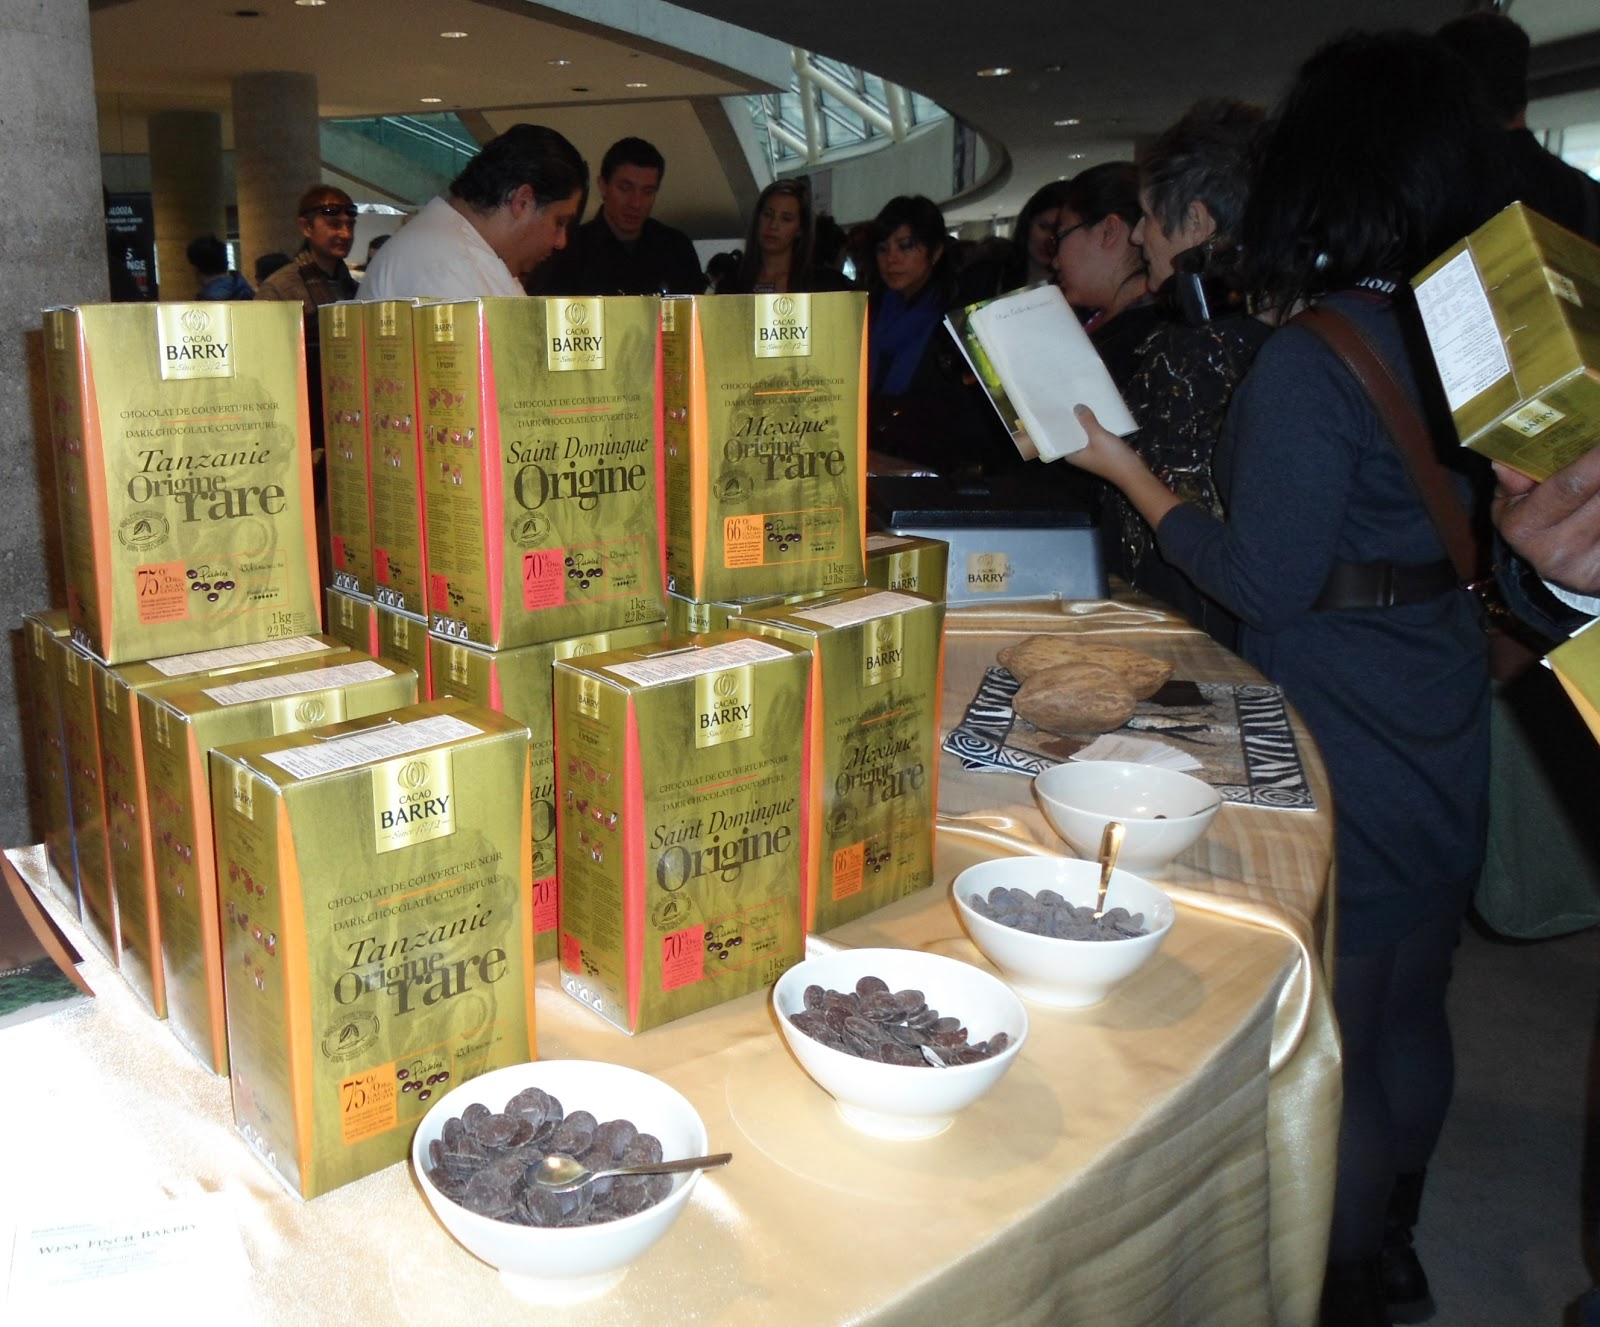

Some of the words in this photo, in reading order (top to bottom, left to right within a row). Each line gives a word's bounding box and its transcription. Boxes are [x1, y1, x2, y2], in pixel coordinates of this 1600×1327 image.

[182, 335, 212, 344] CACAO
[552, 337, 603, 352] BARRY
[565, 328, 590, 336] CACAO
[760, 327, 808, 341] BARRY
[166, 343, 229, 361] BARRY
[119, 408, 175, 419] CHOCOLAT
[176, 407, 190, 416] DE
[192, 404, 254, 416] COUVERTURE
[256, 402, 280, 411] NOIR
[514, 399, 558, 409] CHOCOLAT
[559, 398, 571, 406] DE
[571, 396, 621, 406] COUVERTURE
[621, 394, 641, 402] NOIR
[125, 428, 154, 439] DARK
[155, 425, 214, 437] CHOCOLATE
[215, 421, 277, 433] COUVERTURE
[518, 420, 542, 428] DARK
[542, 416, 590, 426] CHOCOLATE
[590, 413, 639, 422] COUVERTURE
[736, 414, 828, 440] Mexique
[1520, 410, 1555, 433] BARRY
[137, 442, 272, 474] Tanzanie
[506, 440, 559, 464] Saint
[562, 433, 649, 461] Domingue
[724, 436, 801, 464] Origine
[765, 449, 845, 481] rare
[127, 471, 228, 504] Origine
[514, 458, 646, 511] Origine
[182, 484, 286, 523] rare
[891, 576, 918, 590] BARRY
[968, 573, 1005, 583] BARRY
[866, 648, 903, 670] BARRY
[578, 694, 599, 710] BARRY
[700, 704, 752, 729] BARRY
[713, 698, 739, 710] CACAO
[845, 736, 915, 770] Mexique
[659, 776, 703, 793] CHOCOLAT
[705, 773, 717, 783] DE
[717, 761, 769, 780] COUVERTURE
[769, 754, 789, 766] NOIR
[835, 762, 894, 797] Origine
[865, 763, 925, 809] rare
[398, 789, 432, 805] CACAO
[663, 801, 687, 813] DARK
[687, 788, 735, 806] CHOCOLATE
[736, 774, 786, 793] COUVERTURE
[380, 795, 450, 830] BARRY
[650, 820, 703, 850] Saint
[707, 798, 795, 835] Domingue
[656, 825, 792, 892] Origine
[327, 886, 389, 910] CHOCOLAT
[390, 882, 406, 894] DE
[408, 859, 476, 887] COUVERTURE
[478, 851, 503, 867] NOIR
[333, 916, 365, 932] DARK
[367, 896, 433, 923] CHOCOLATE
[434, 875, 500, 904] COUVERTURE
[346, 903, 493, 971] Tanzanie
[334, 952, 445, 1006] Origine
[394, 948, 507, 1017] rare
